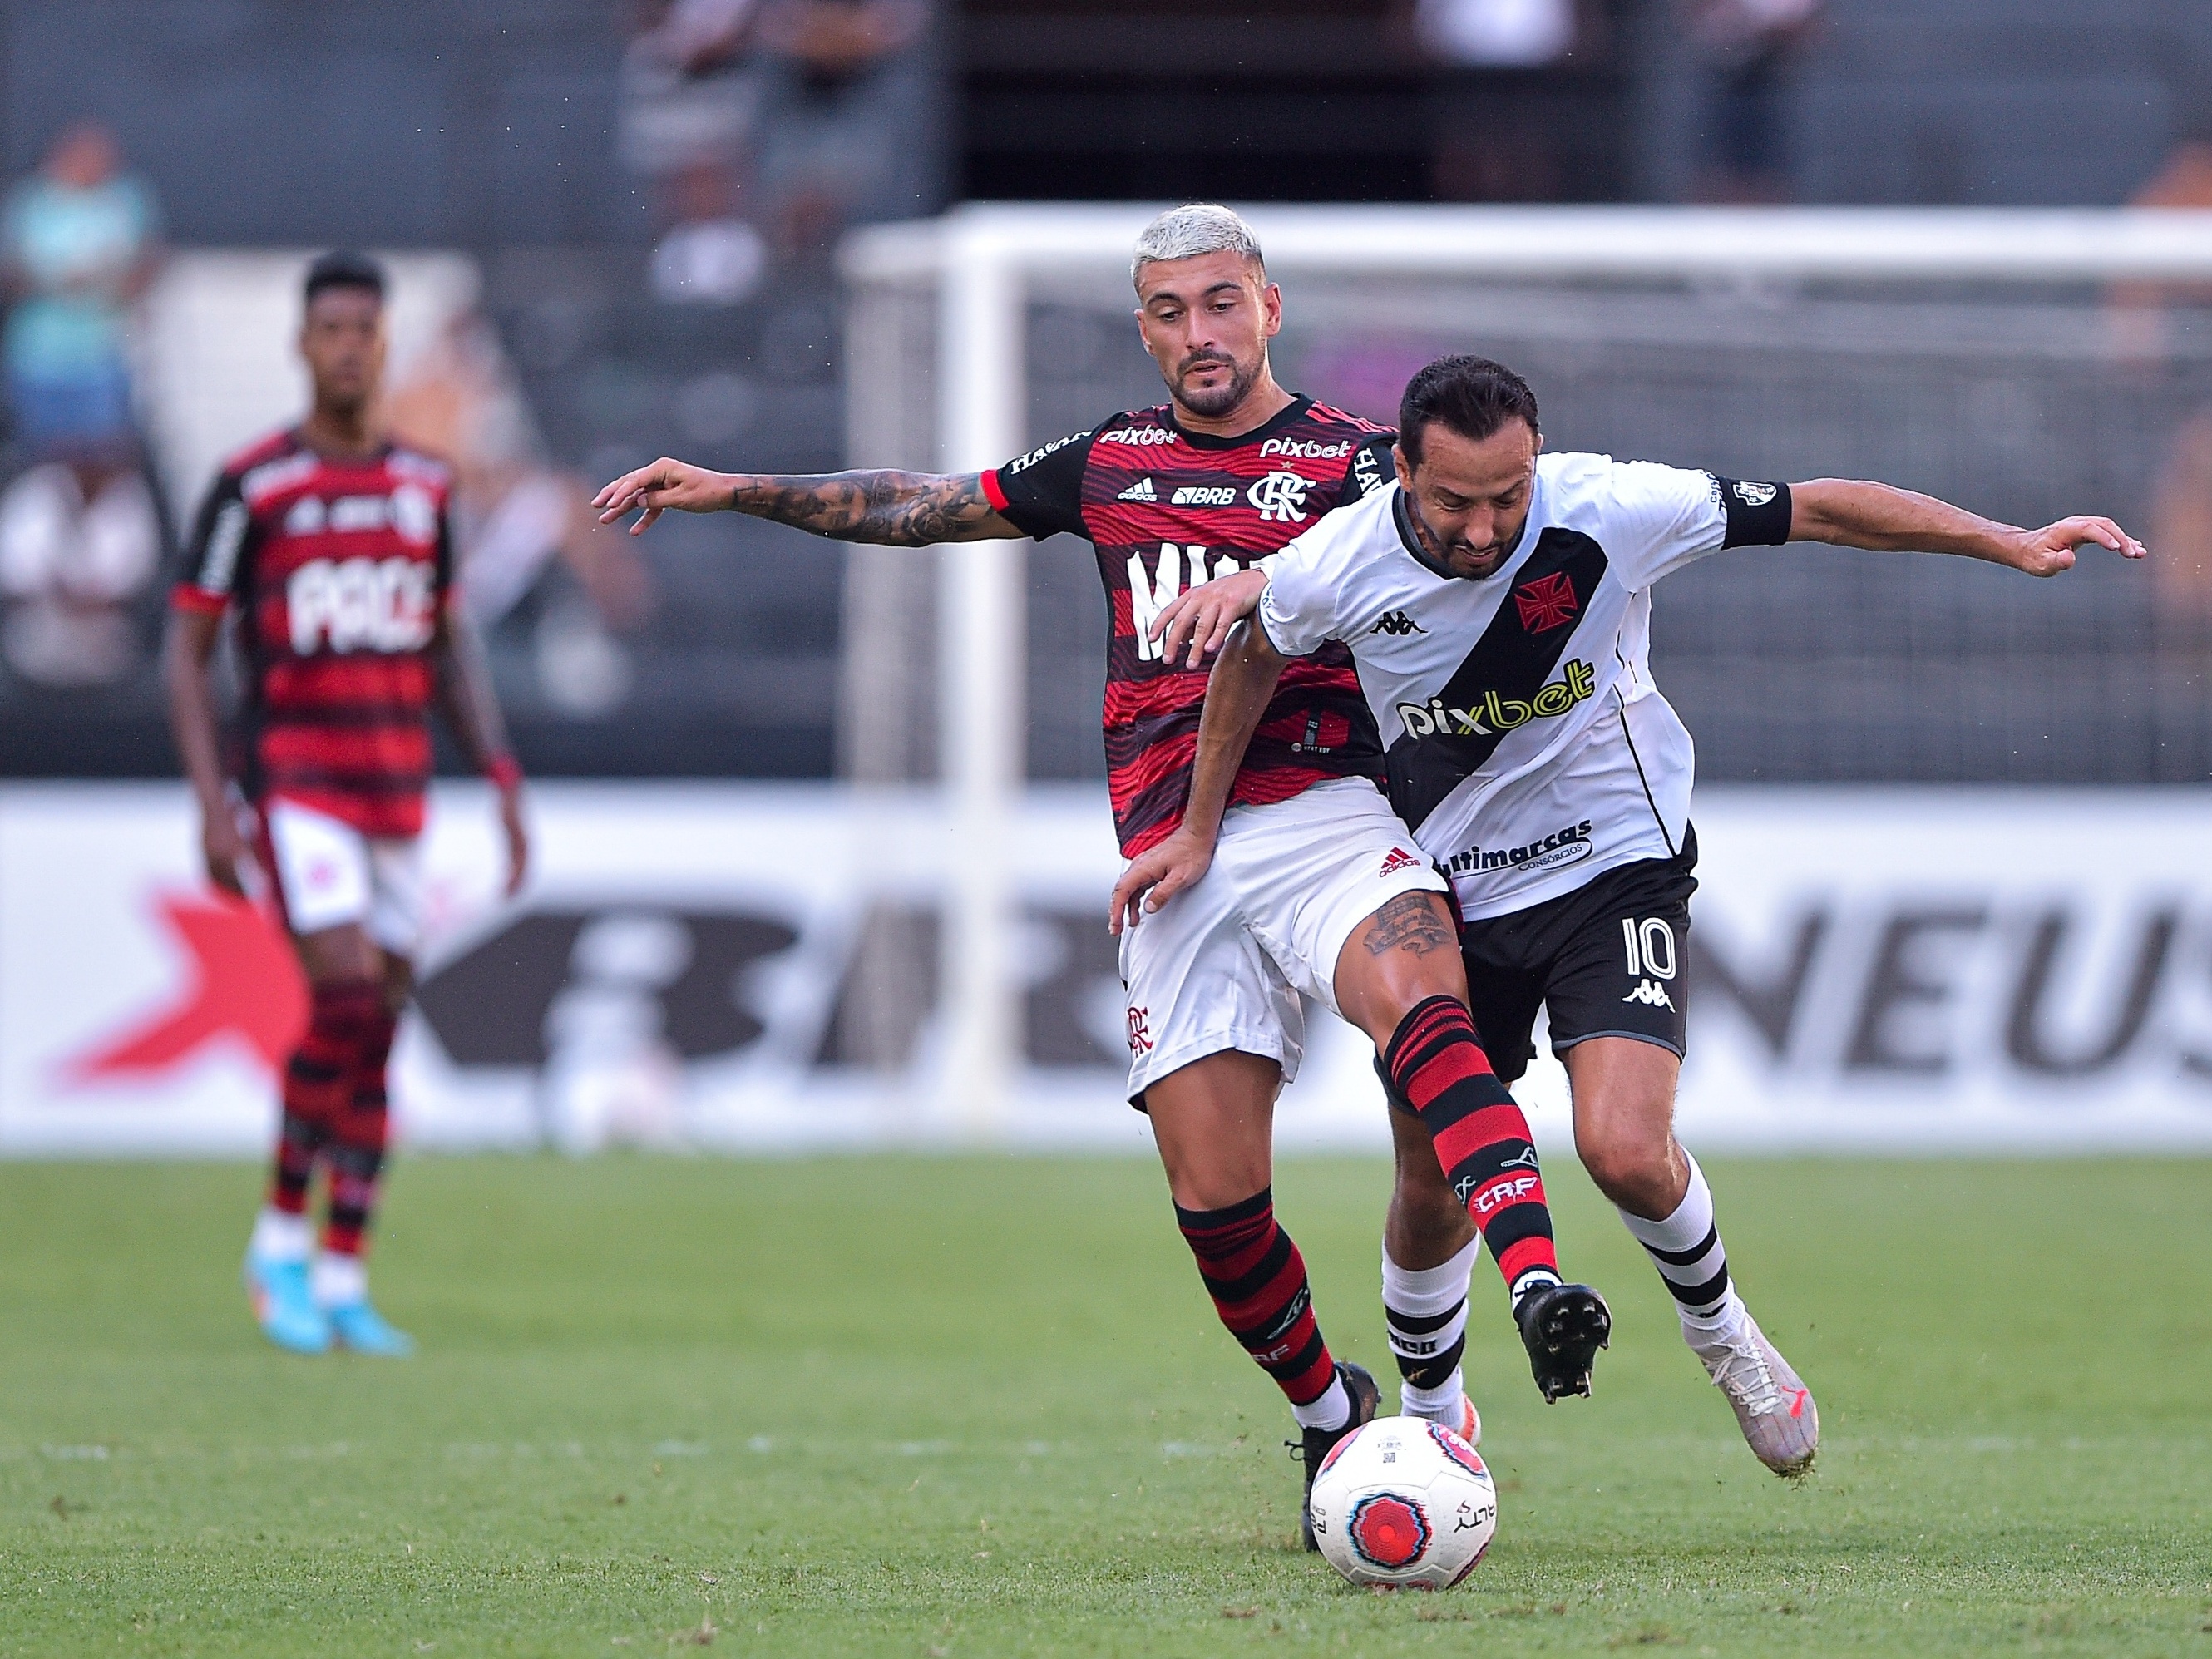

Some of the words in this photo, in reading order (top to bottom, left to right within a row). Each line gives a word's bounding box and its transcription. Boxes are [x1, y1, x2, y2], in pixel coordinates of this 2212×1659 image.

[1098, 424, 1178, 447] pixbet
[1259, 436, 1352, 459] pixbet
[1117, 491, 1158, 502] adidas
[1192, 487, 1237, 506] BRB
[1396, 658, 1595, 740] pixbet
[1432, 819, 1592, 876] ultimarcas
[1378, 857, 1421, 878] adidas
[1621, 916, 1677, 982] 10
